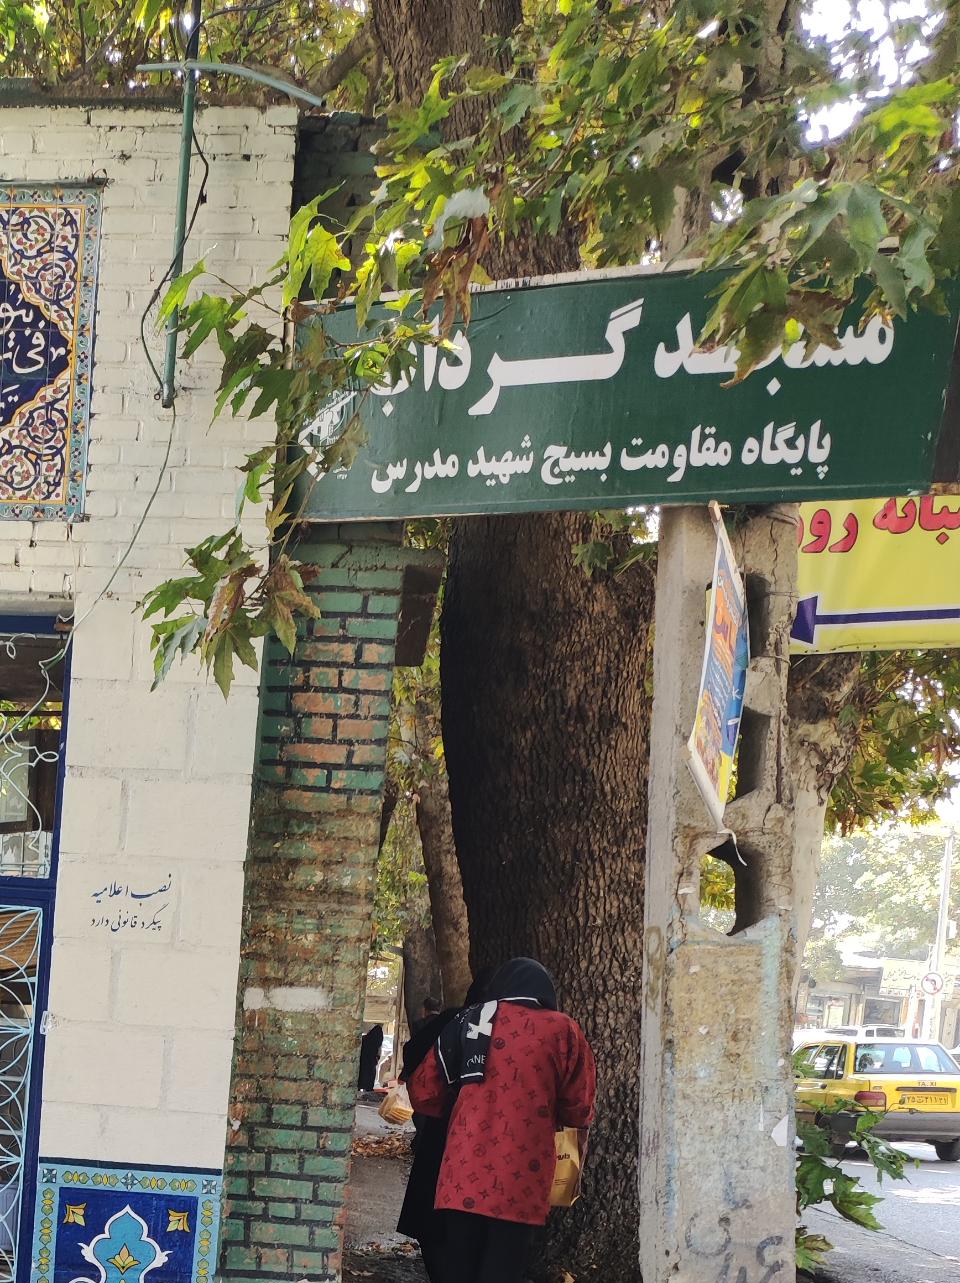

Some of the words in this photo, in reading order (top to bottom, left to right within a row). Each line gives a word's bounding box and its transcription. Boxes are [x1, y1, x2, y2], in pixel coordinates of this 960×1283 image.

[371, 447, 459, 494] مدرس
[467, 434, 534, 487] شهید
[540, 441, 612, 485] بسیج
[620, 424, 732, 483] مقاومت
[741, 419, 831, 480] پایگاه
[91, 880, 129, 903] اعلامیه
[131, 873, 172, 907] نصب
[90, 916, 109, 927] دارد
[111, 909, 138, 932] قانونی
